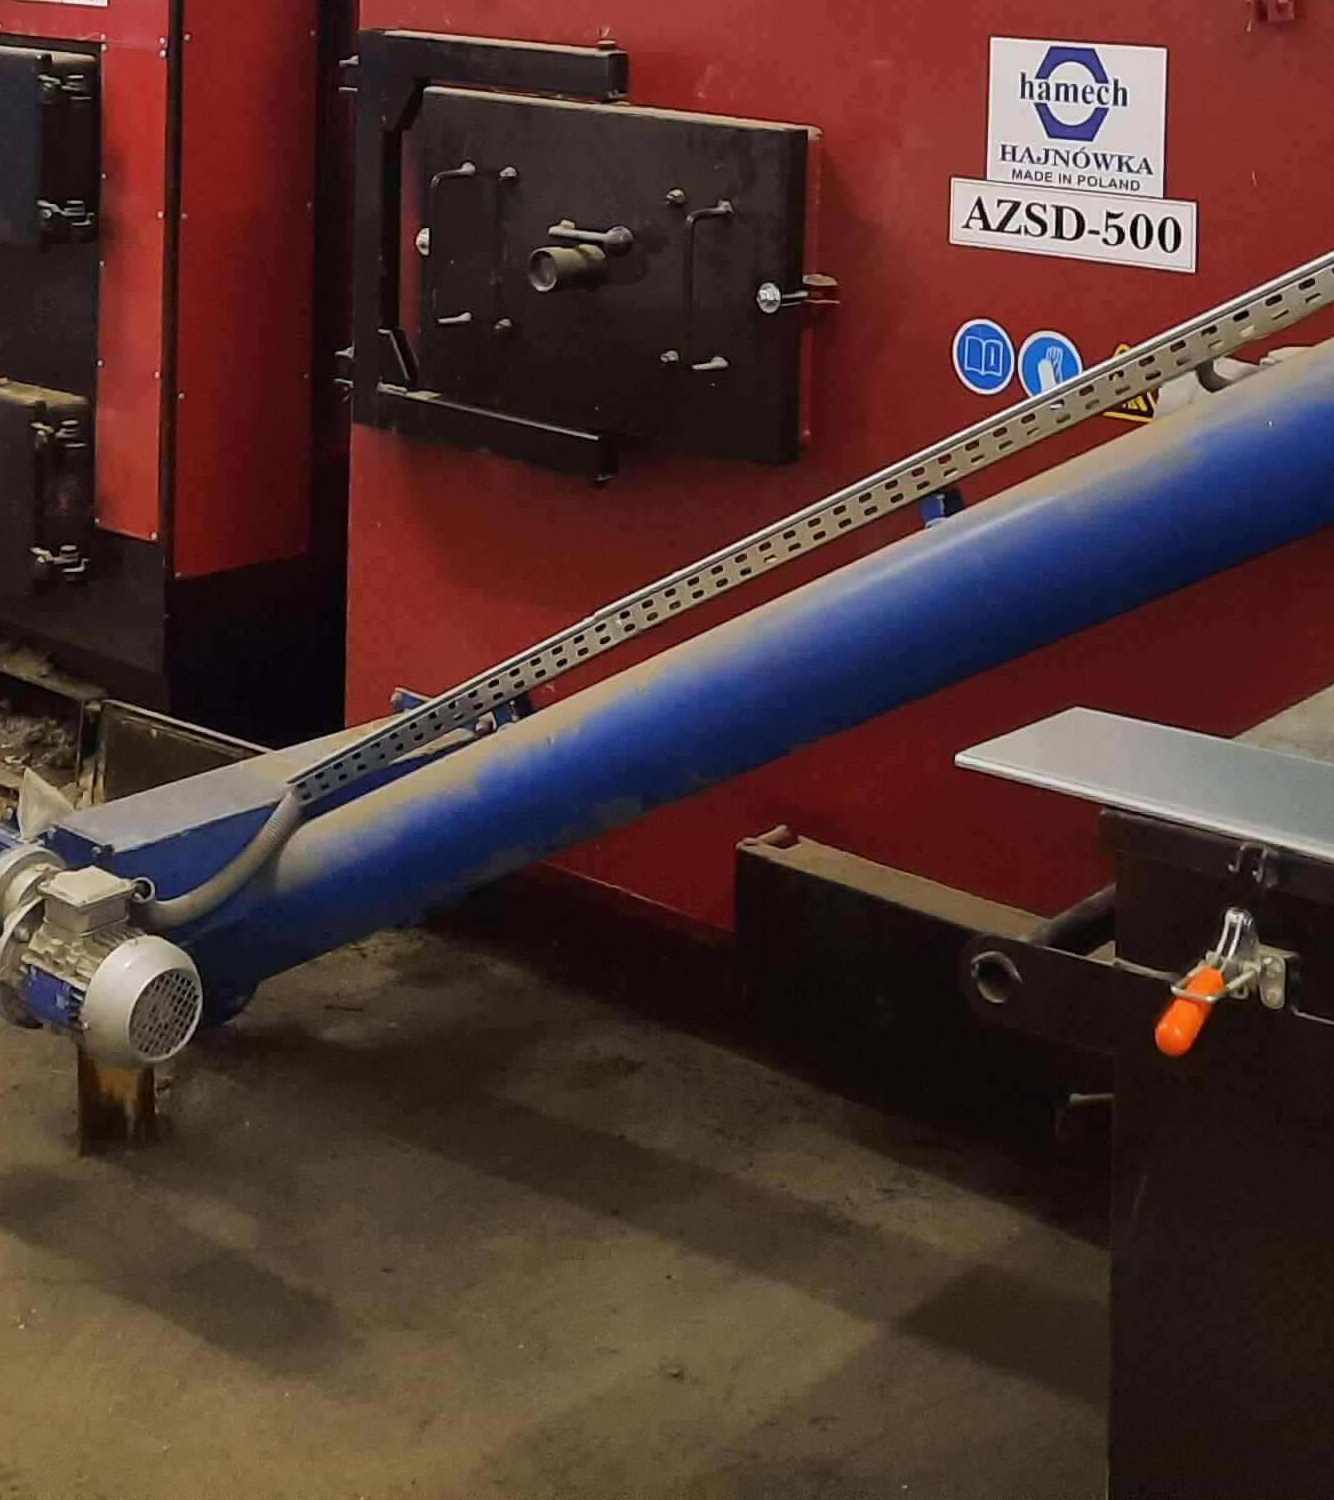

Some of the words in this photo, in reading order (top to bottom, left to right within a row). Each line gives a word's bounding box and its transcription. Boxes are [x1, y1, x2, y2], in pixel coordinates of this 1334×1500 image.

[1019, 72, 1128, 108] hamech
[999, 144, 1154, 175] HAJNÓWKA
[1011, 168, 1053, 183] MADE
[1058, 172, 1072, 186] IN
[1077, 174, 1142, 192] POLAND
[961, 195, 1183, 254] AZSD-500
